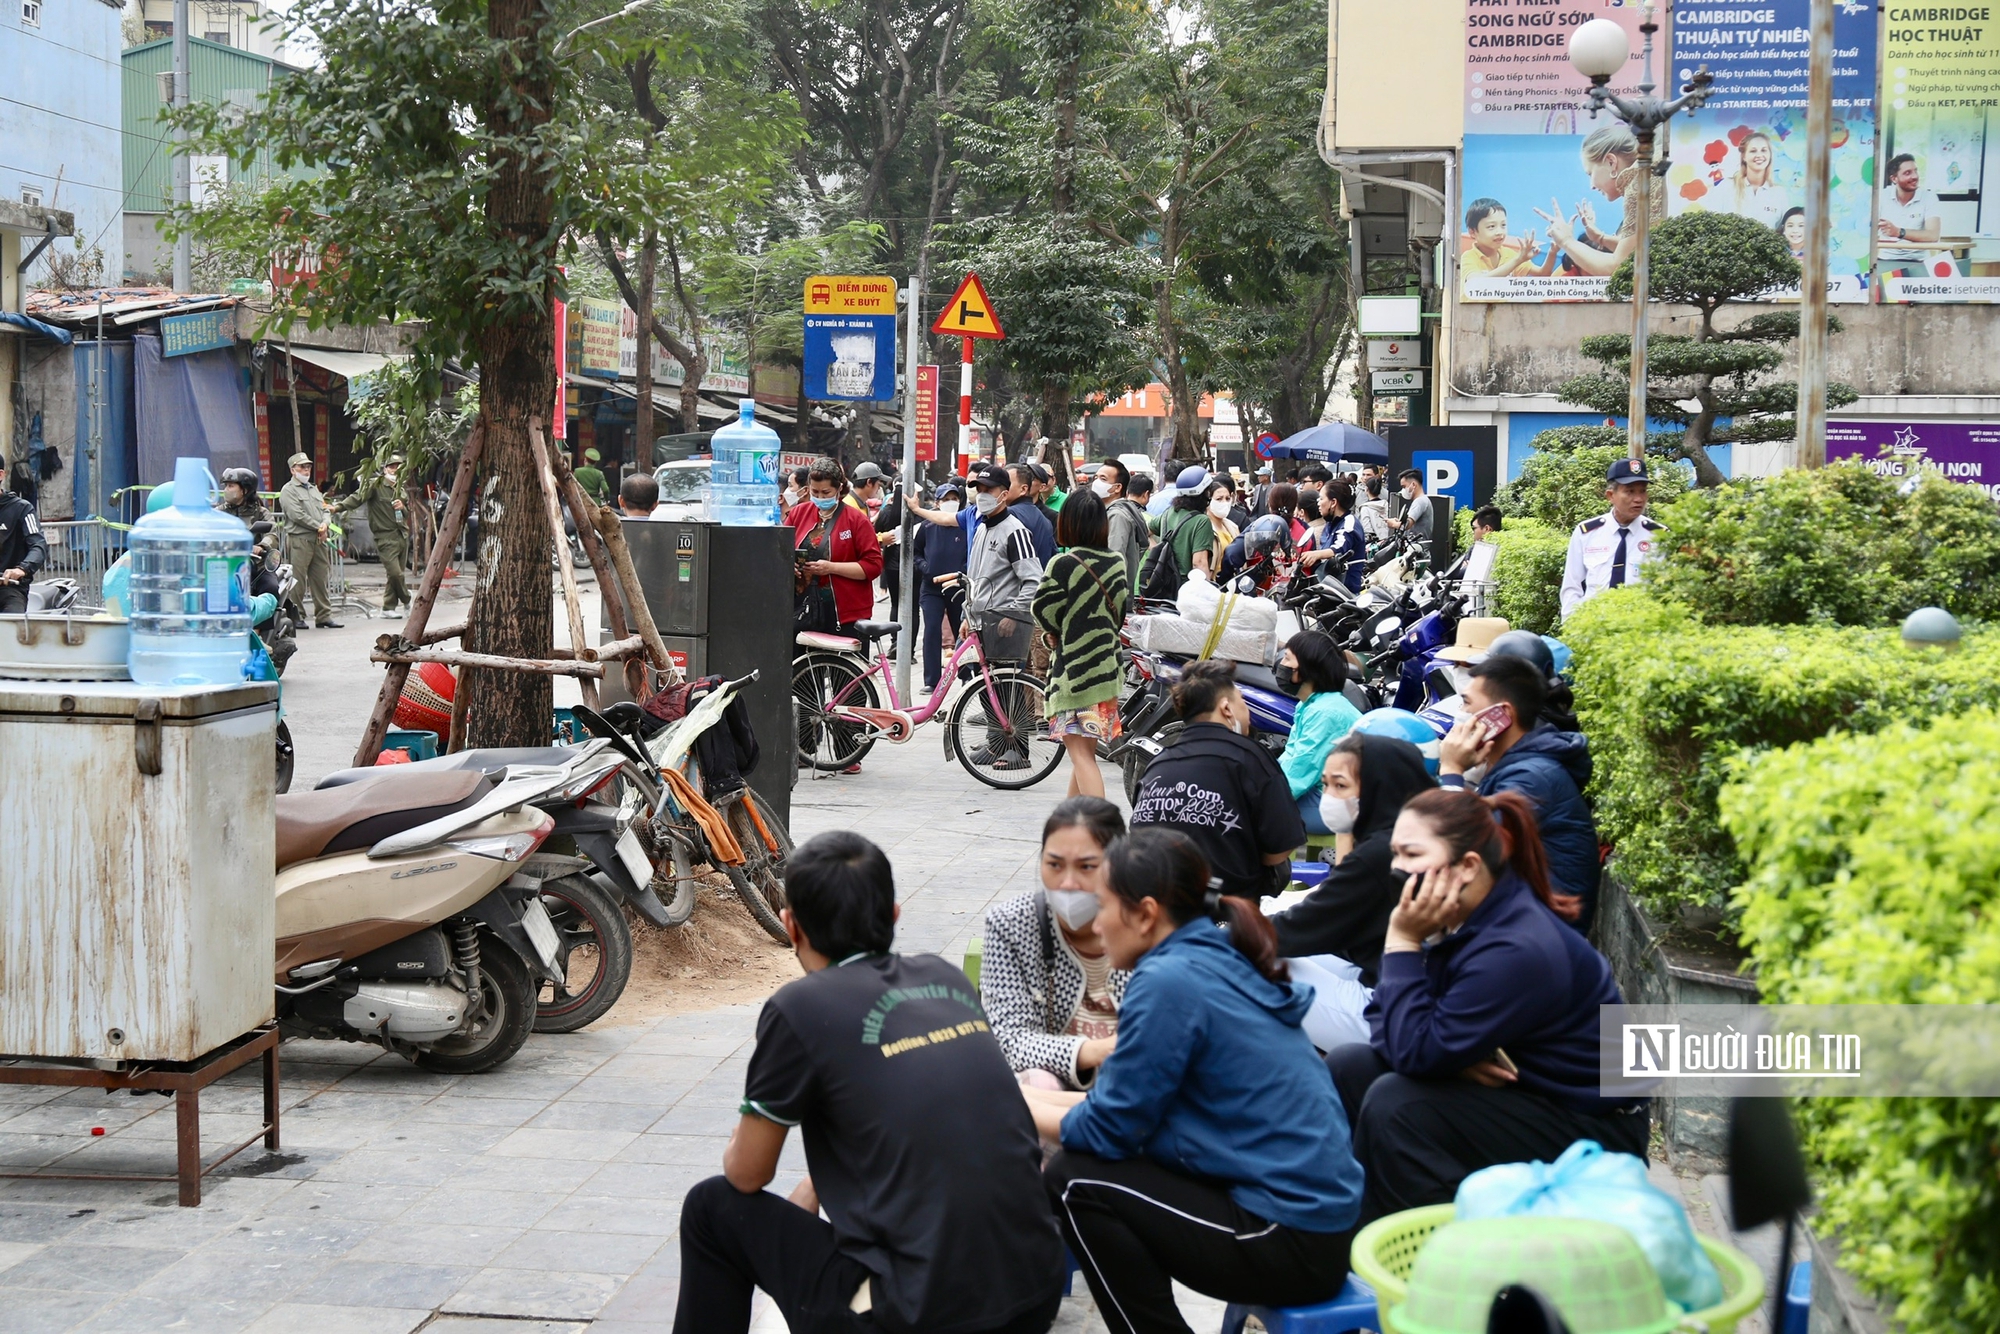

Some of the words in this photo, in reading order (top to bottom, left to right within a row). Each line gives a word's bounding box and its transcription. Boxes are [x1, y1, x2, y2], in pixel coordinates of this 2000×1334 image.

[1468, 14, 1514, 27] SONG
[1518, 11, 1555, 27] NGỮ
[1558, 10, 1595, 26] SỚM
[1675, 10, 1775, 24] CAMBRIDGE
[1889, 8, 1990, 21] CAMBRIDGE
[1468, 34, 1565, 48] CAMBRIDGE
[1675, 29, 1733, 48] THUẬN
[1736, 28, 1761, 48] TỰ
[1763, 27, 1812, 44] NHIÊN
[1889, 29, 1924, 46] HỌC
[1928, 26, 1983, 45] THUẬT
[1675, 51, 1700, 61] Dành
[1702, 50, 1719, 60] cho
[1721, 50, 1738, 62] học
[1740, 49, 1759, 59] sinh
[1761, 49, 1779, 59] tiểu
[1781, 49, 1798, 61] học
[1838, 47, 1859, 58] tuổi
[1888, 50, 1914, 59] Dành
[1915, 50, 1933, 59] cho
[1935, 50, 1952, 61] học
[1954, 49, 1974, 58] sinh
[1468, 54, 1494, 63] Dành
[1495, 54, 1512, 63] cho
[1513, 54, 1530, 65] học
[1531, 53, 1552, 63] sinh
[1485, 73, 1505, 82] Giao
[1506, 72, 1523, 83] tiếp
[1525, 73, 1534, 83] tự
[1535, 72, 1560, 81] nhiên
[1715, 67, 1733, 80] tiếp
[1733, 68, 1744, 81] tự
[1745, 67, 1773, 79] nhiên,
[1774, 66, 1803, 79] thuyết
[1841, 67, 1859, 77] bản
[1909, 68, 1939, 79] Thuyết
[1525, 87, 1558, 97] Phonics
[1730, 84, 1741, 94] từ
[1742, 84, 1764, 97] vựng
[1765, 84, 1788, 96] vững
[1514, 102, 1582, 112] PRE-STARTERS,
[1722, 99, 1772, 110] STARTERS,
[1853, 98, 1872, 107] KET
[1938, 99, 1957, 108] KET,
[1960, 99, 1978, 108] PET,
[1981, 99, 1998, 107] PRE
[837, 282, 860, 293] ĐIỂM
[862, 283, 888, 293] DỪNG
[1509, 279, 1528, 288] Tầng
[1570, 279, 1594, 288] Thạch
[1475, 289, 1493, 297] Trần
[1494, 289, 1525, 299] Nguyên
[1547, 289, 1566, 299] Định
[1901, 284, 1952, 295] Website:
[844, 298, 855, 306] XE
[858, 297, 881, 306] BUÝT
[1381, 377, 1404, 385] VCBR
[1948, 462, 1982, 477] NON
[1426, 459, 1459, 496] P
[680, 538, 691, 548] 10
[1187, 783, 1225, 804] Corp.
[390, 861, 458, 879] LEAD
